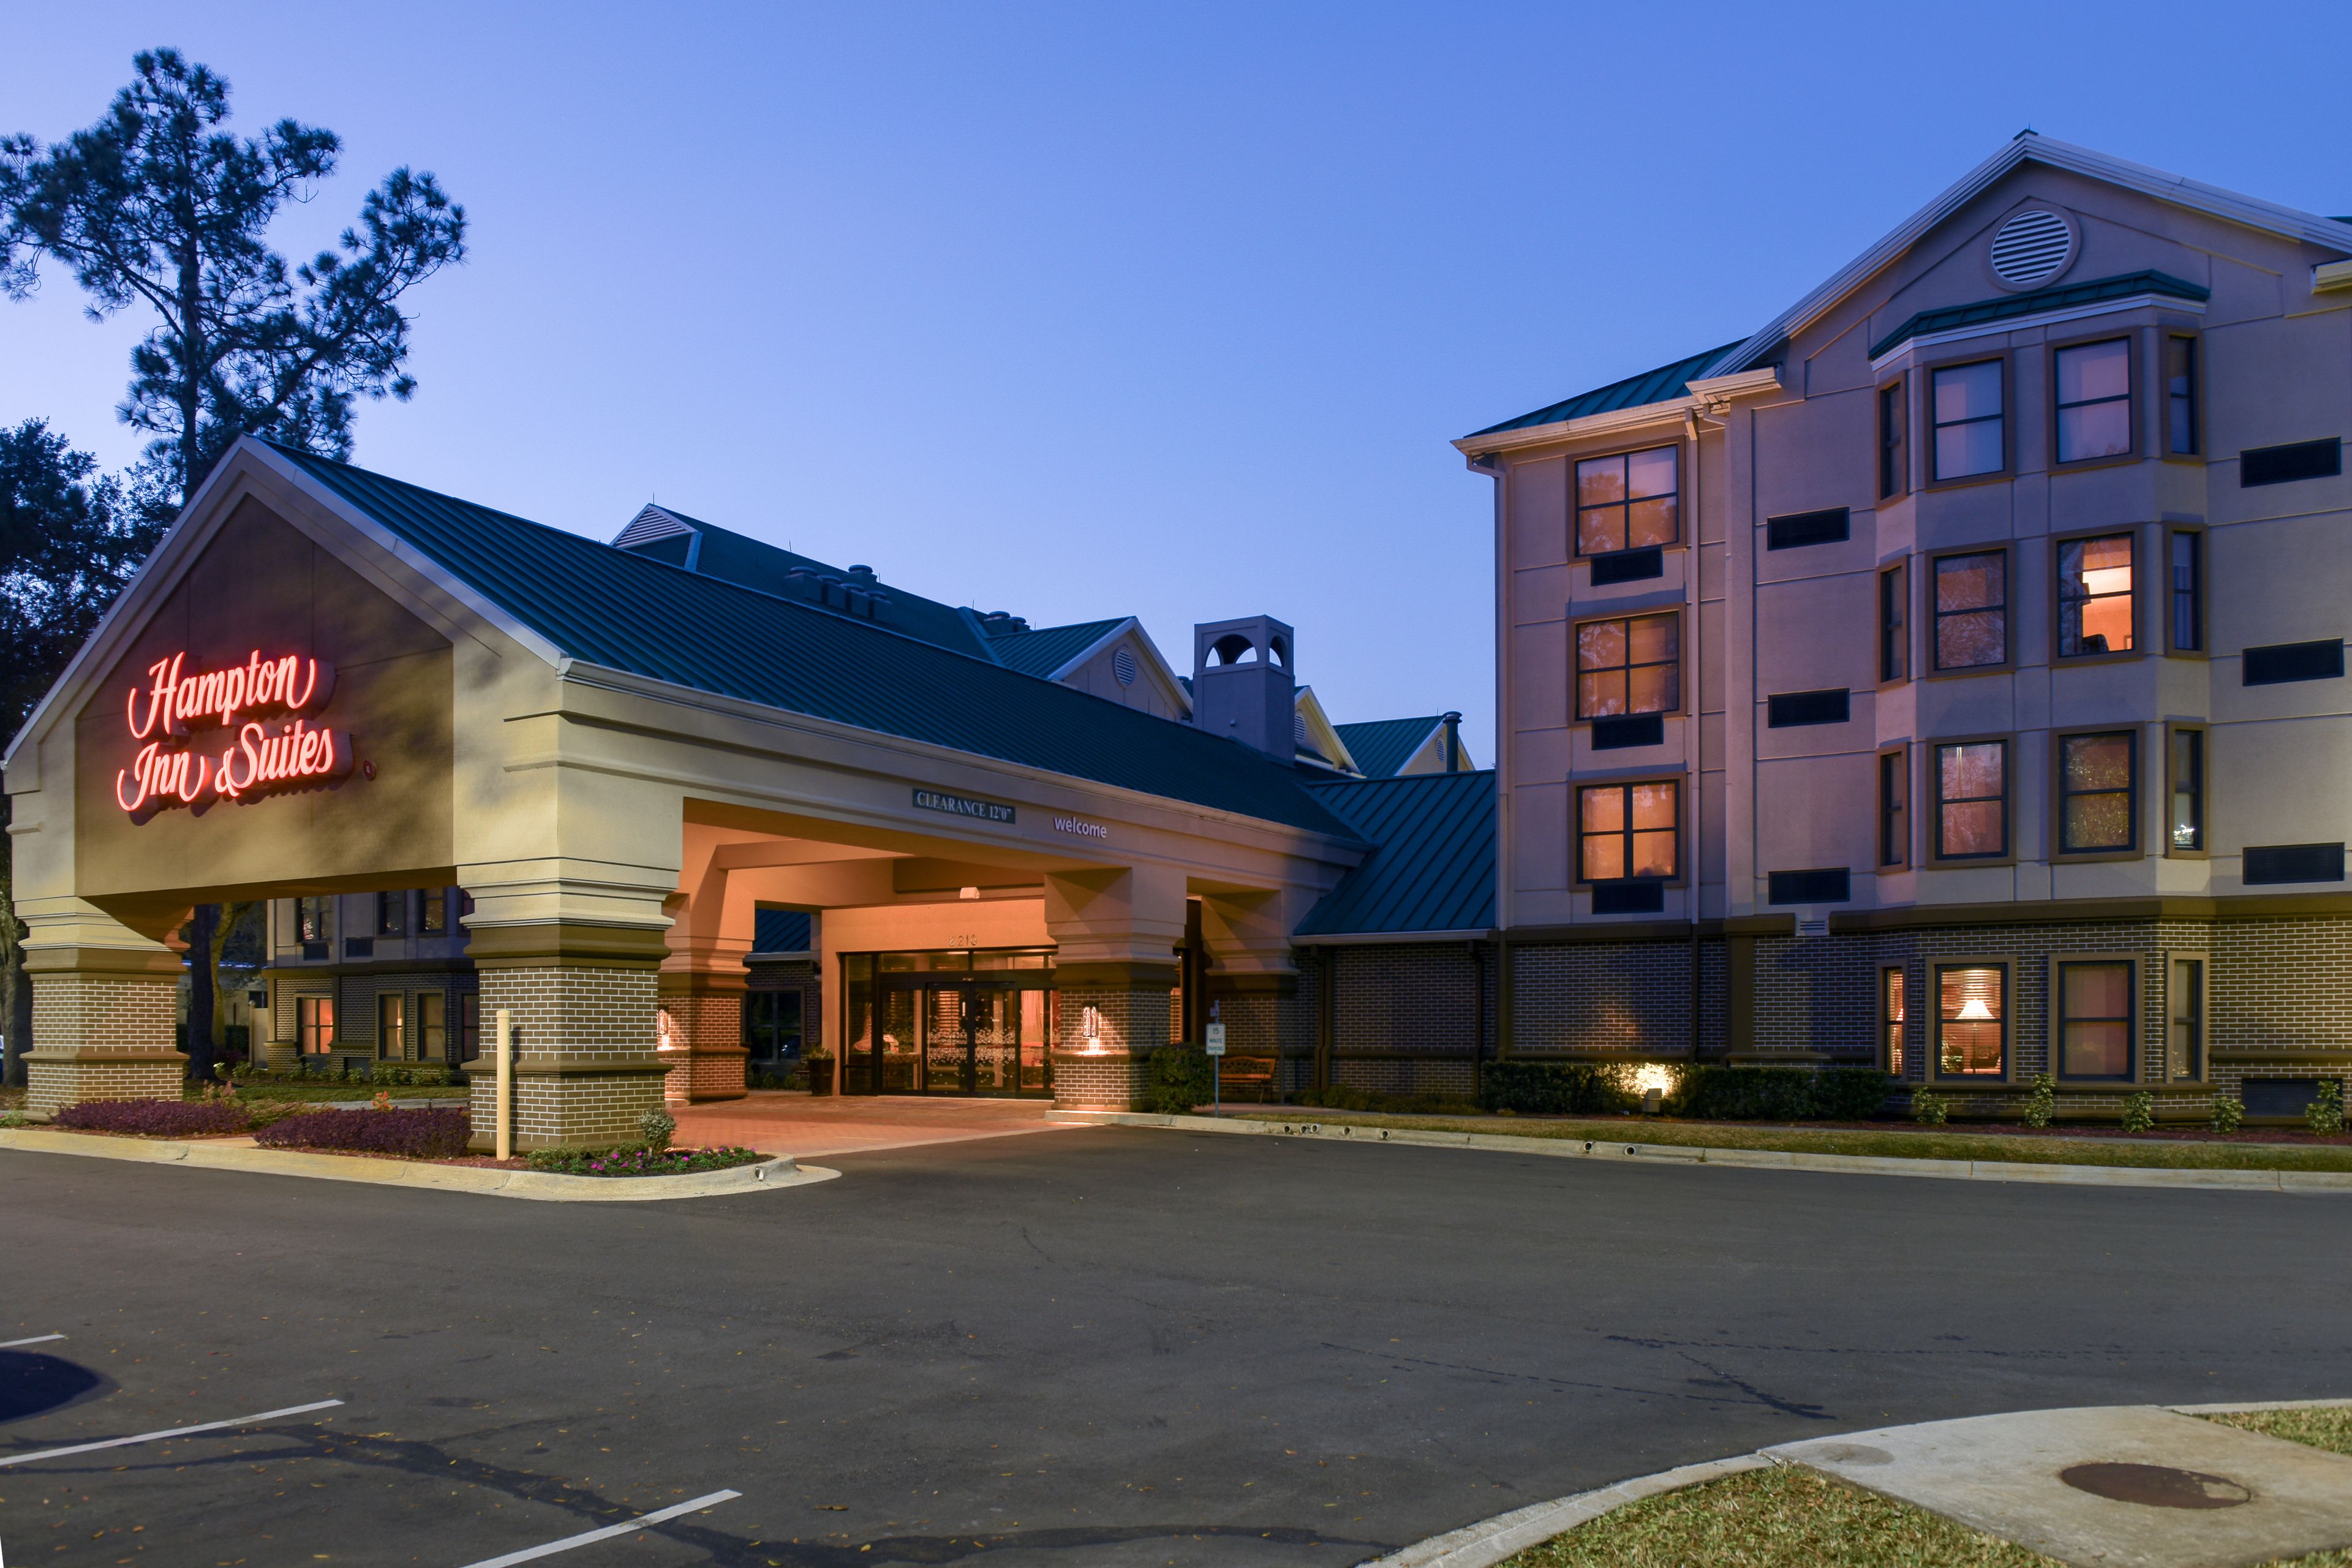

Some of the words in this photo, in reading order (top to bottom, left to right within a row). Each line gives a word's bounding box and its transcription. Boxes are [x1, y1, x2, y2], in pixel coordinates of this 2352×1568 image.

[128, 649, 317, 739] Hampton
[116, 742, 206, 811] Inn
[214, 750, 240, 797] &
[225, 719, 334, 789] Suites
[917, 791, 986, 817] CLEARANCE
[1054, 816, 1107, 839] welcome
[949, 933, 978, 947] 6210
